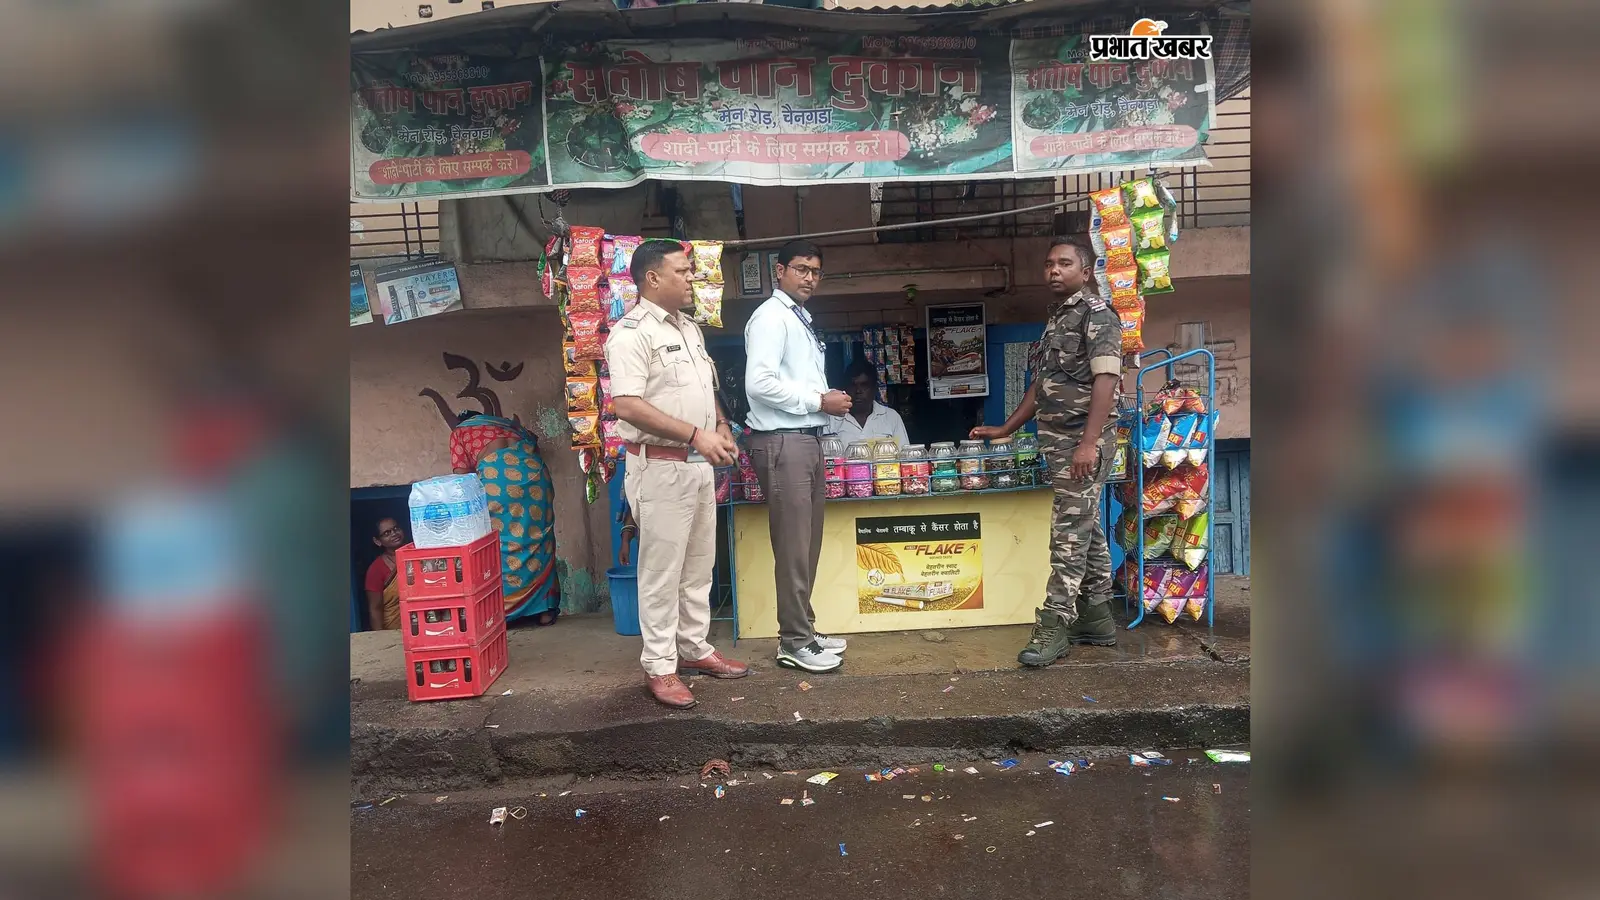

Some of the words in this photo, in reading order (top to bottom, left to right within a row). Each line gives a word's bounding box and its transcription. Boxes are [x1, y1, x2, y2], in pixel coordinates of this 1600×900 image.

[716, 56, 816, 99] पान
[827, 56, 982, 111] दुकान
[1089, 60, 1129, 89] पान
[423, 88, 465, 116] पान
[467, 81, 532, 122] दुकान
[1065, 102, 1089, 118] मेन
[718, 105, 744, 125] मेन
[397, 125, 420, 143] मेन
[1097, 134, 1107, 150] के
[1110, 131, 1130, 149] लिए
[663, 134, 742, 157] शादी-पार्टी
[746, 136, 760, 157] के
[765, 135, 797, 160] लिए
[802, 133, 850, 157] सम्पर्क
[425, 158, 436, 176] के
[438, 157, 460, 176] लिए
[463, 154, 493, 173] सम्पर्क
[415, 271, 455, 284] PLAYER'S
[893, 524, 916, 535] तम्बाकू
[920, 522, 927, 532] से
[931, 521, 949, 532] कैंसर
[953, 520, 968, 531] होता
[972, 519, 979, 530] है
[916, 543, 965, 556] FLAKE
